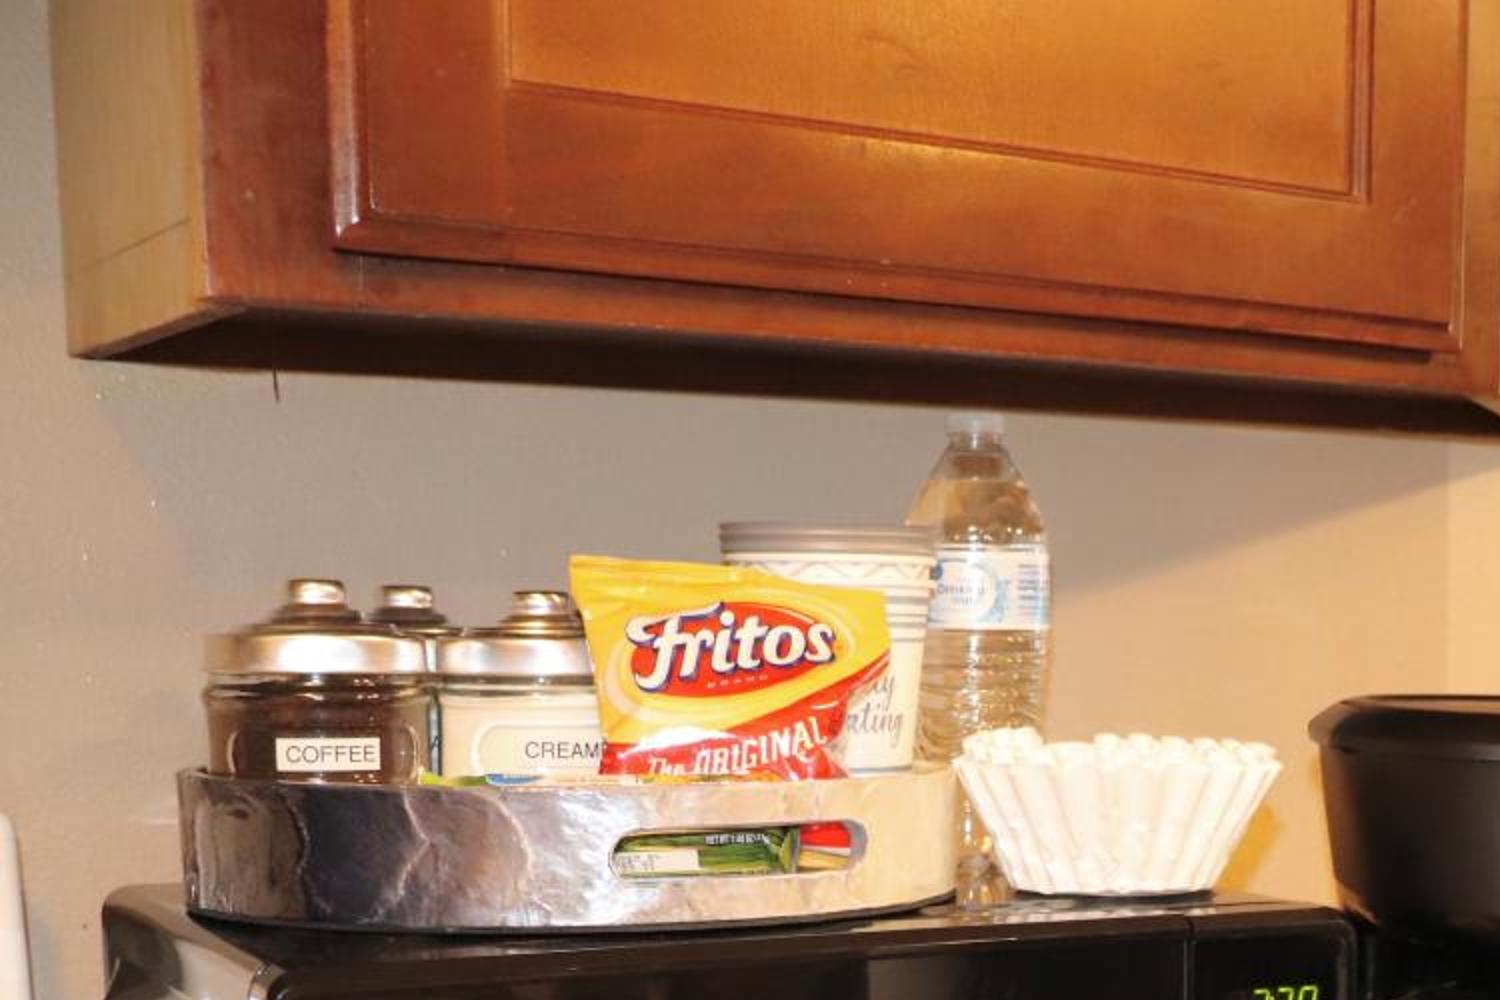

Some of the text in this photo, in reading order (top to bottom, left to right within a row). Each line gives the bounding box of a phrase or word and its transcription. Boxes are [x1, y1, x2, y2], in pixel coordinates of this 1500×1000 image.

[625, 601, 834, 692] Fritos
[285, 743, 377, 764] COFFEE
[648, 716, 828, 776] The ORIGINAL
